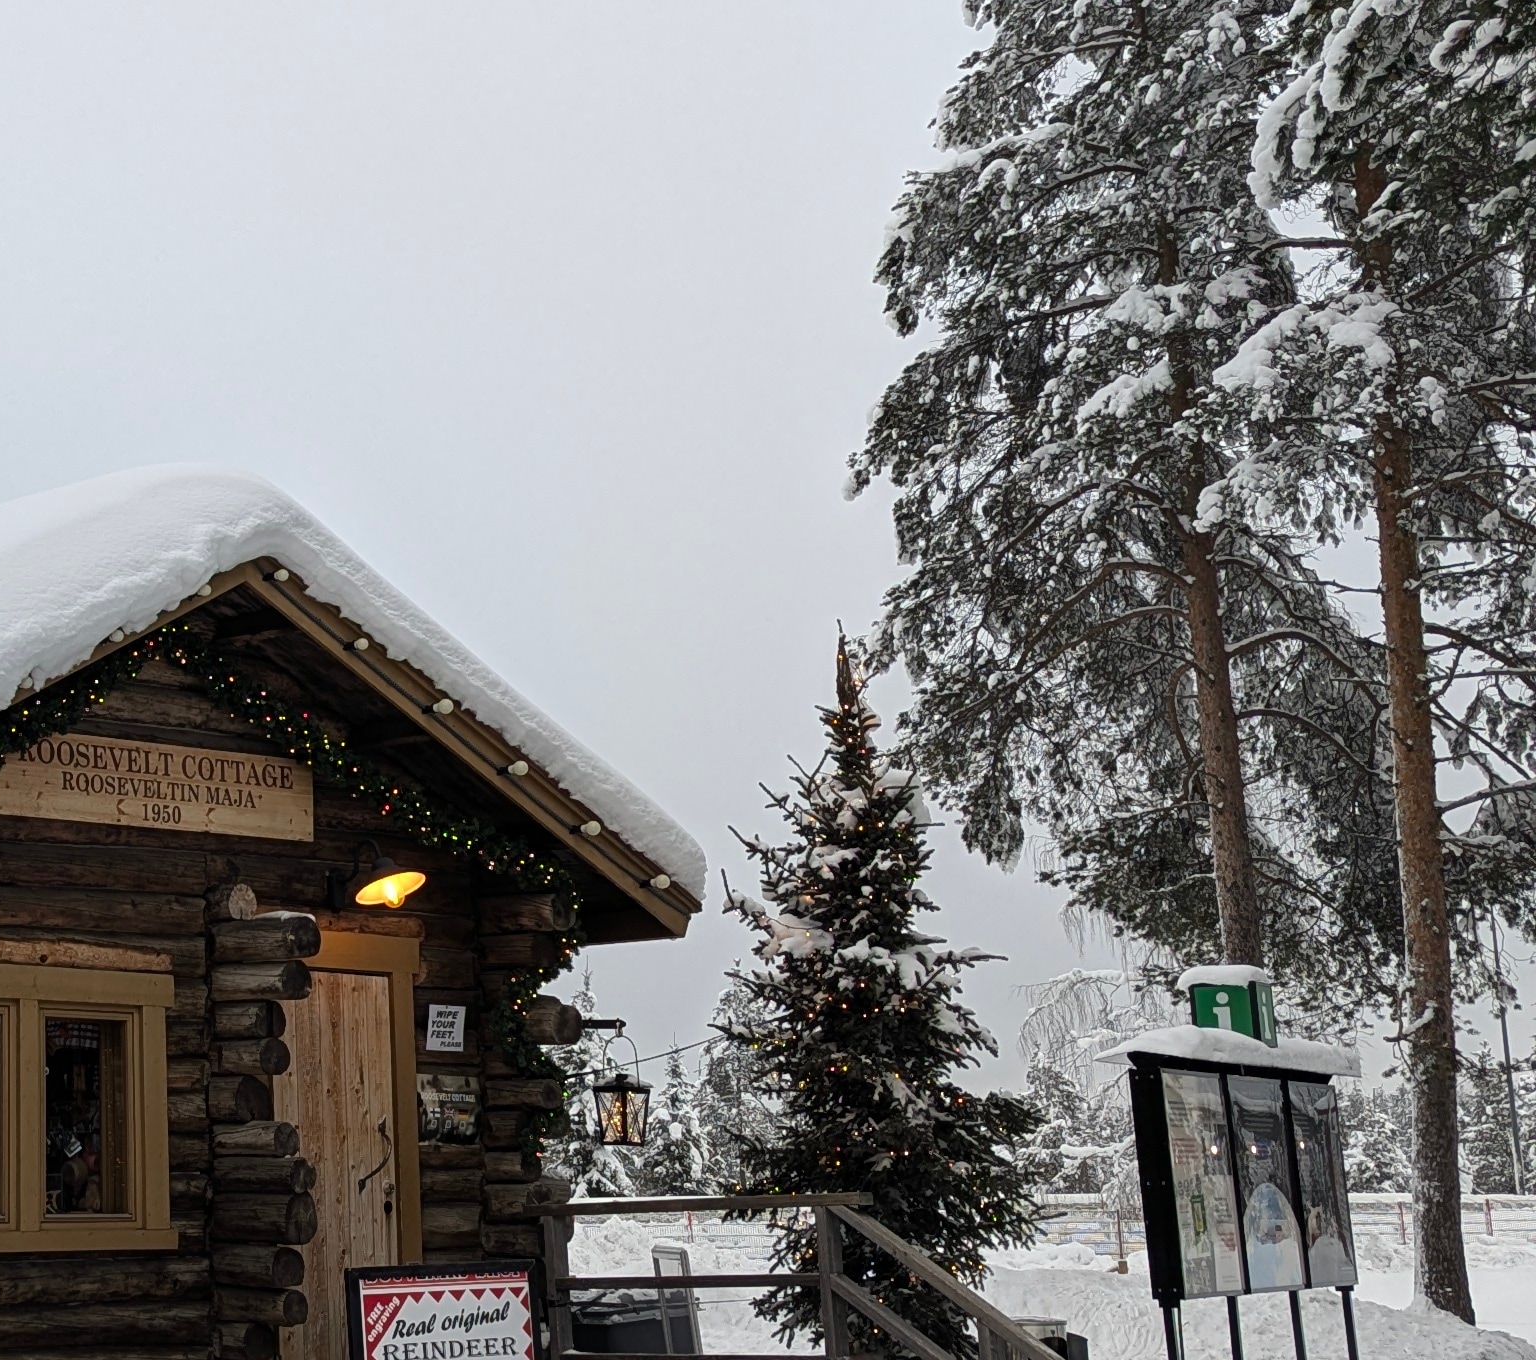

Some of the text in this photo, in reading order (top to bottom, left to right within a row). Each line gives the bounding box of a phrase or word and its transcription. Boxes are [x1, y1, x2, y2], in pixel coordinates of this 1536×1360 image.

[18, 738, 294, 790] ROOSEVELT COTTAGE
[61, 771, 257, 809] ROOSEVELTIN MAJA
[141, 803, 182, 825] 1950
[431, 1020, 456, 1029] YOUR
[436, 1010, 459, 1020] WIPE
[430, 1030, 455, 1041] FEET,
[367, 1301, 385, 1326] FREE
[367, 1295, 401, 1342] engraving
[392, 1300, 511, 1340] Real original
